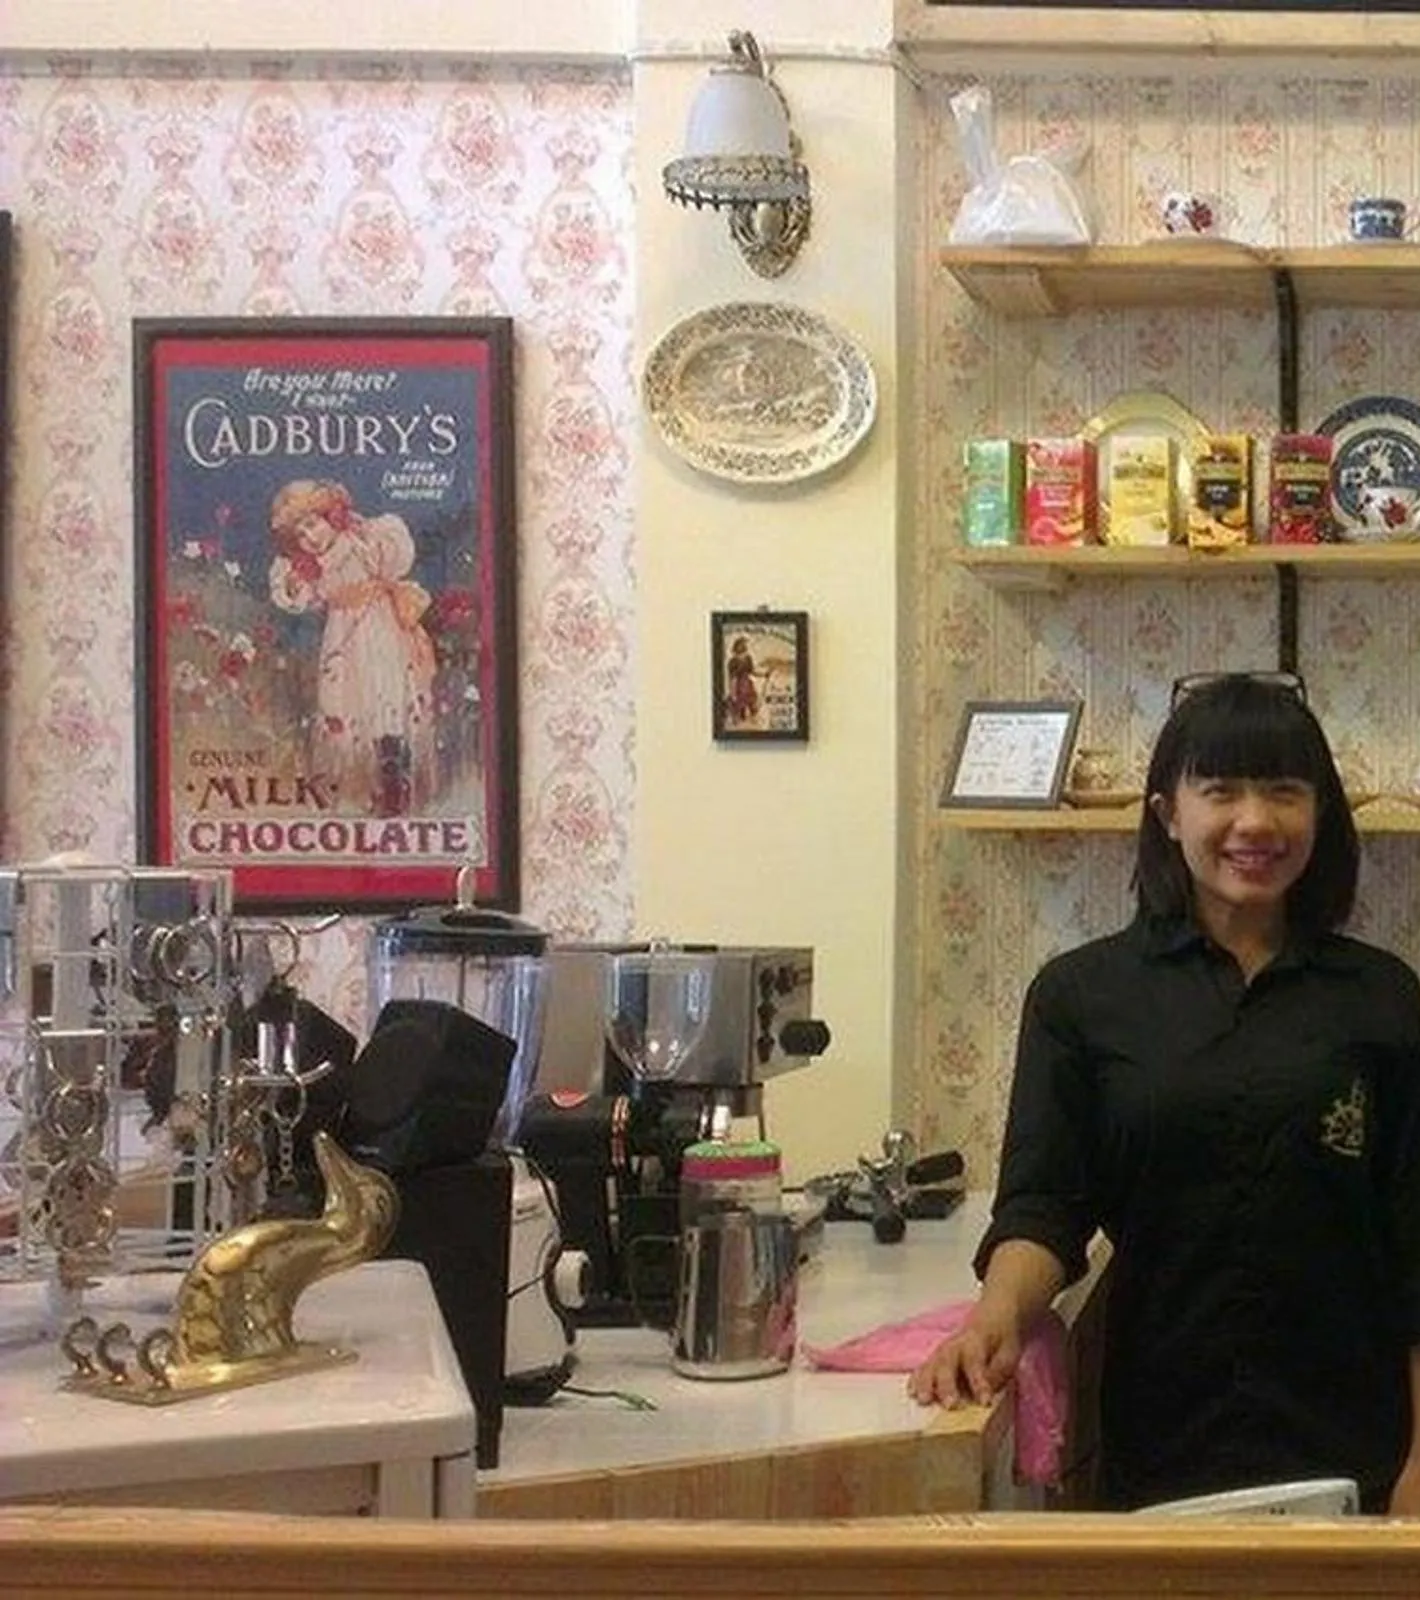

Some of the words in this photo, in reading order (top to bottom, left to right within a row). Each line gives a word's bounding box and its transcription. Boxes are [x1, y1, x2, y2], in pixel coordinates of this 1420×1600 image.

[243, 368, 280, 392] Are
[185, 398, 458, 468] CADBURY'S
[188, 821, 470, 854] CHOCOLATE
